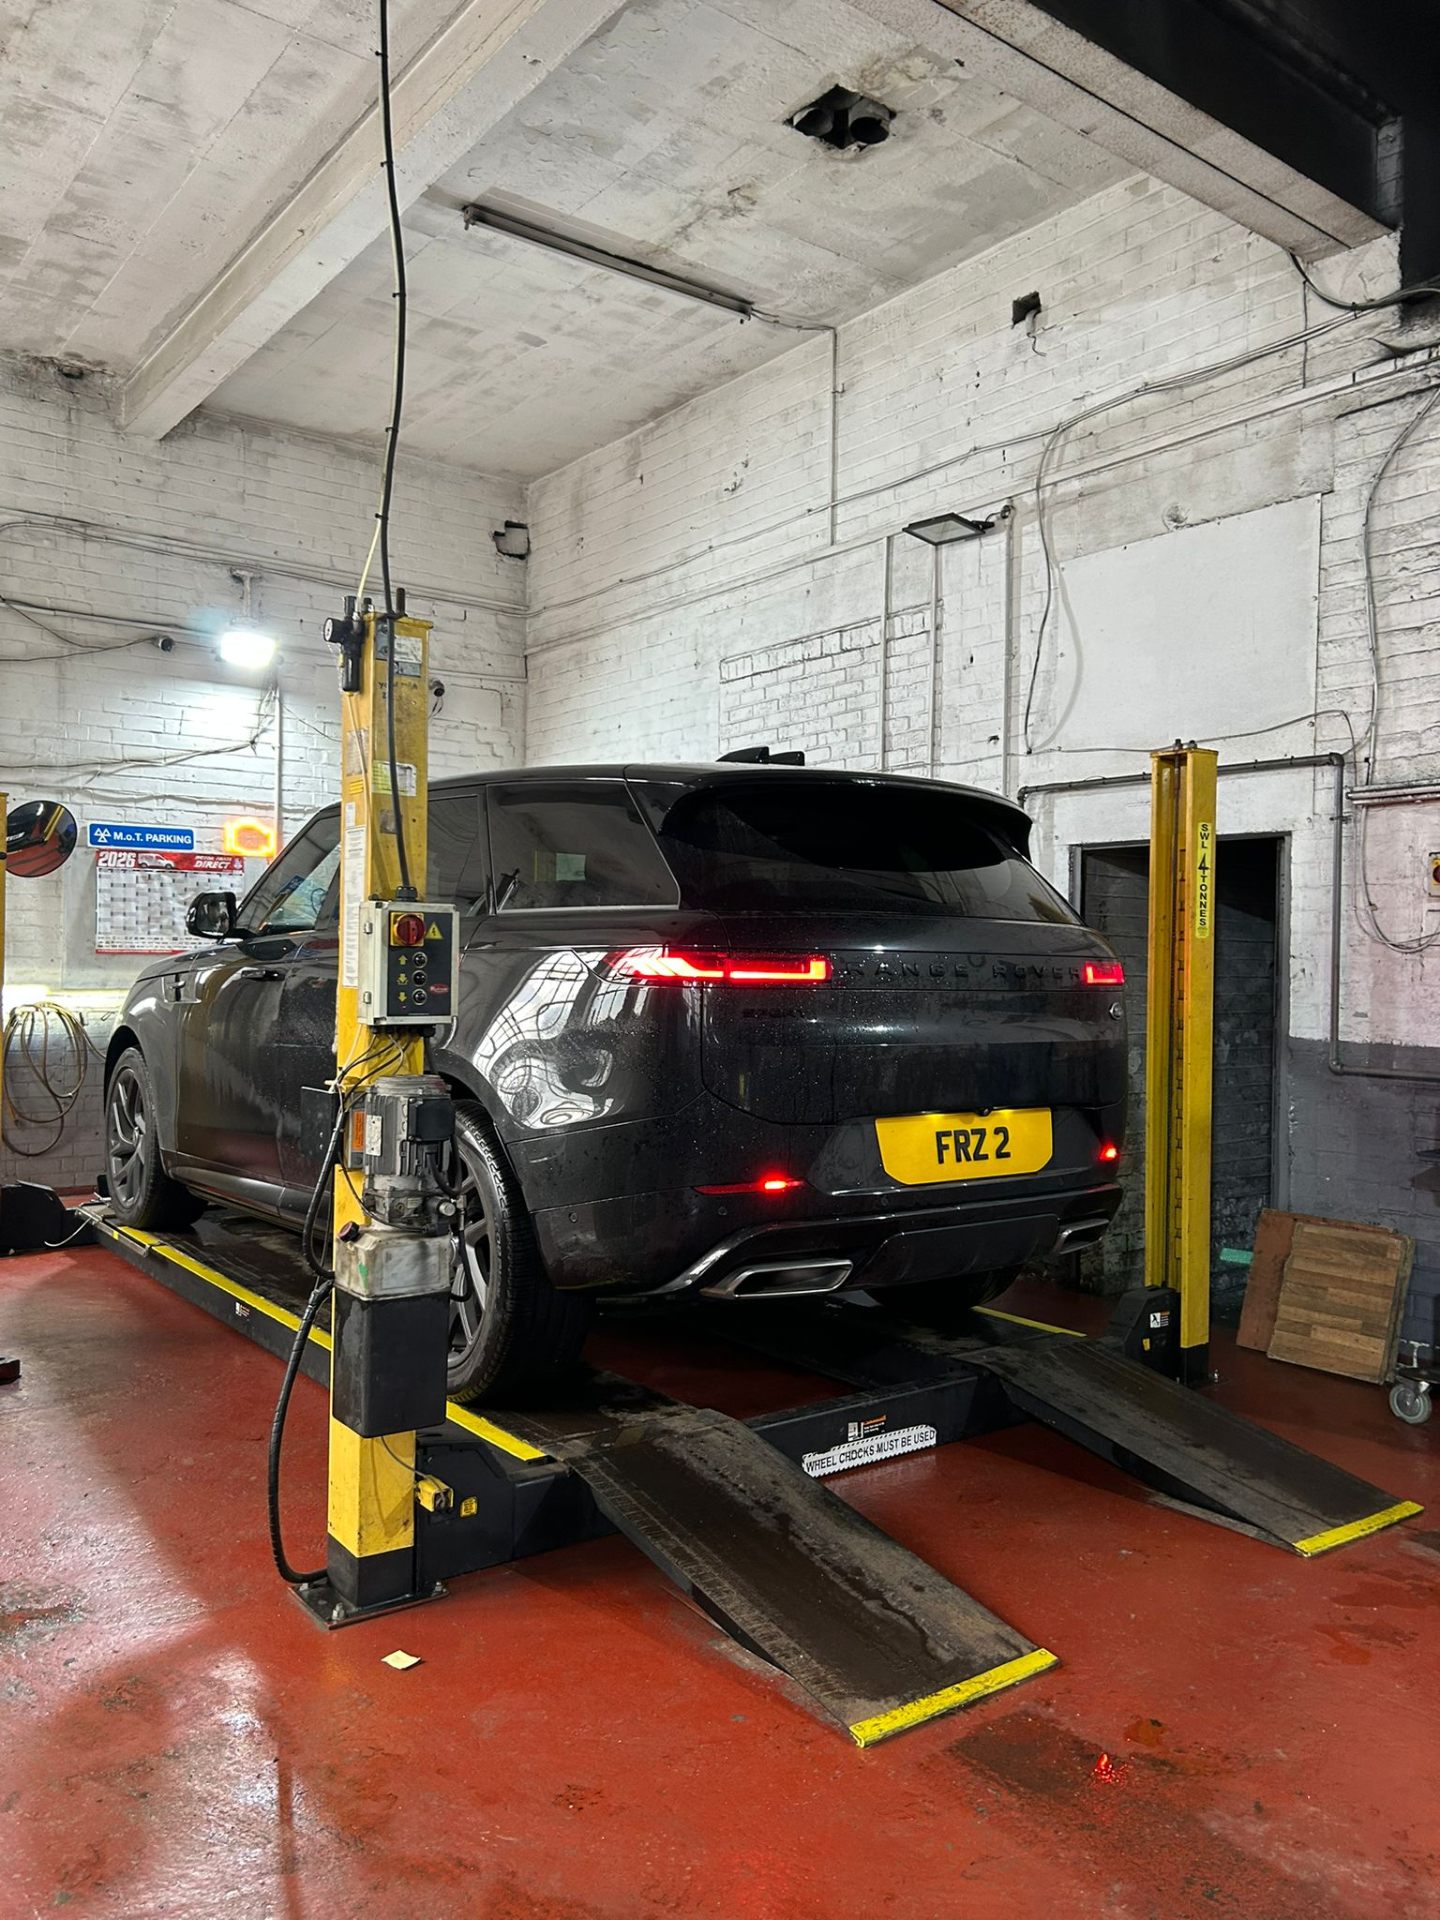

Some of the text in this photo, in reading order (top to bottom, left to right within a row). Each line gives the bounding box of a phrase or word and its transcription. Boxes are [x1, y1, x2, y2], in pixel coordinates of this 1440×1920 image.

[113, 831, 192, 845] M.o.T. PARKING
[1199, 823, 1210, 849] SWL
[97, 851, 137, 868] 2026
[193, 860, 231, 869] DIRECT
[1197, 853, 1210, 875] 4
[1199, 875, 1208, 927] TONNES
[935, 1126, 1012, 1165] FRZ 2
[806, 1430, 935, 1473] WHEEL CHOCKS MUST BE USED
